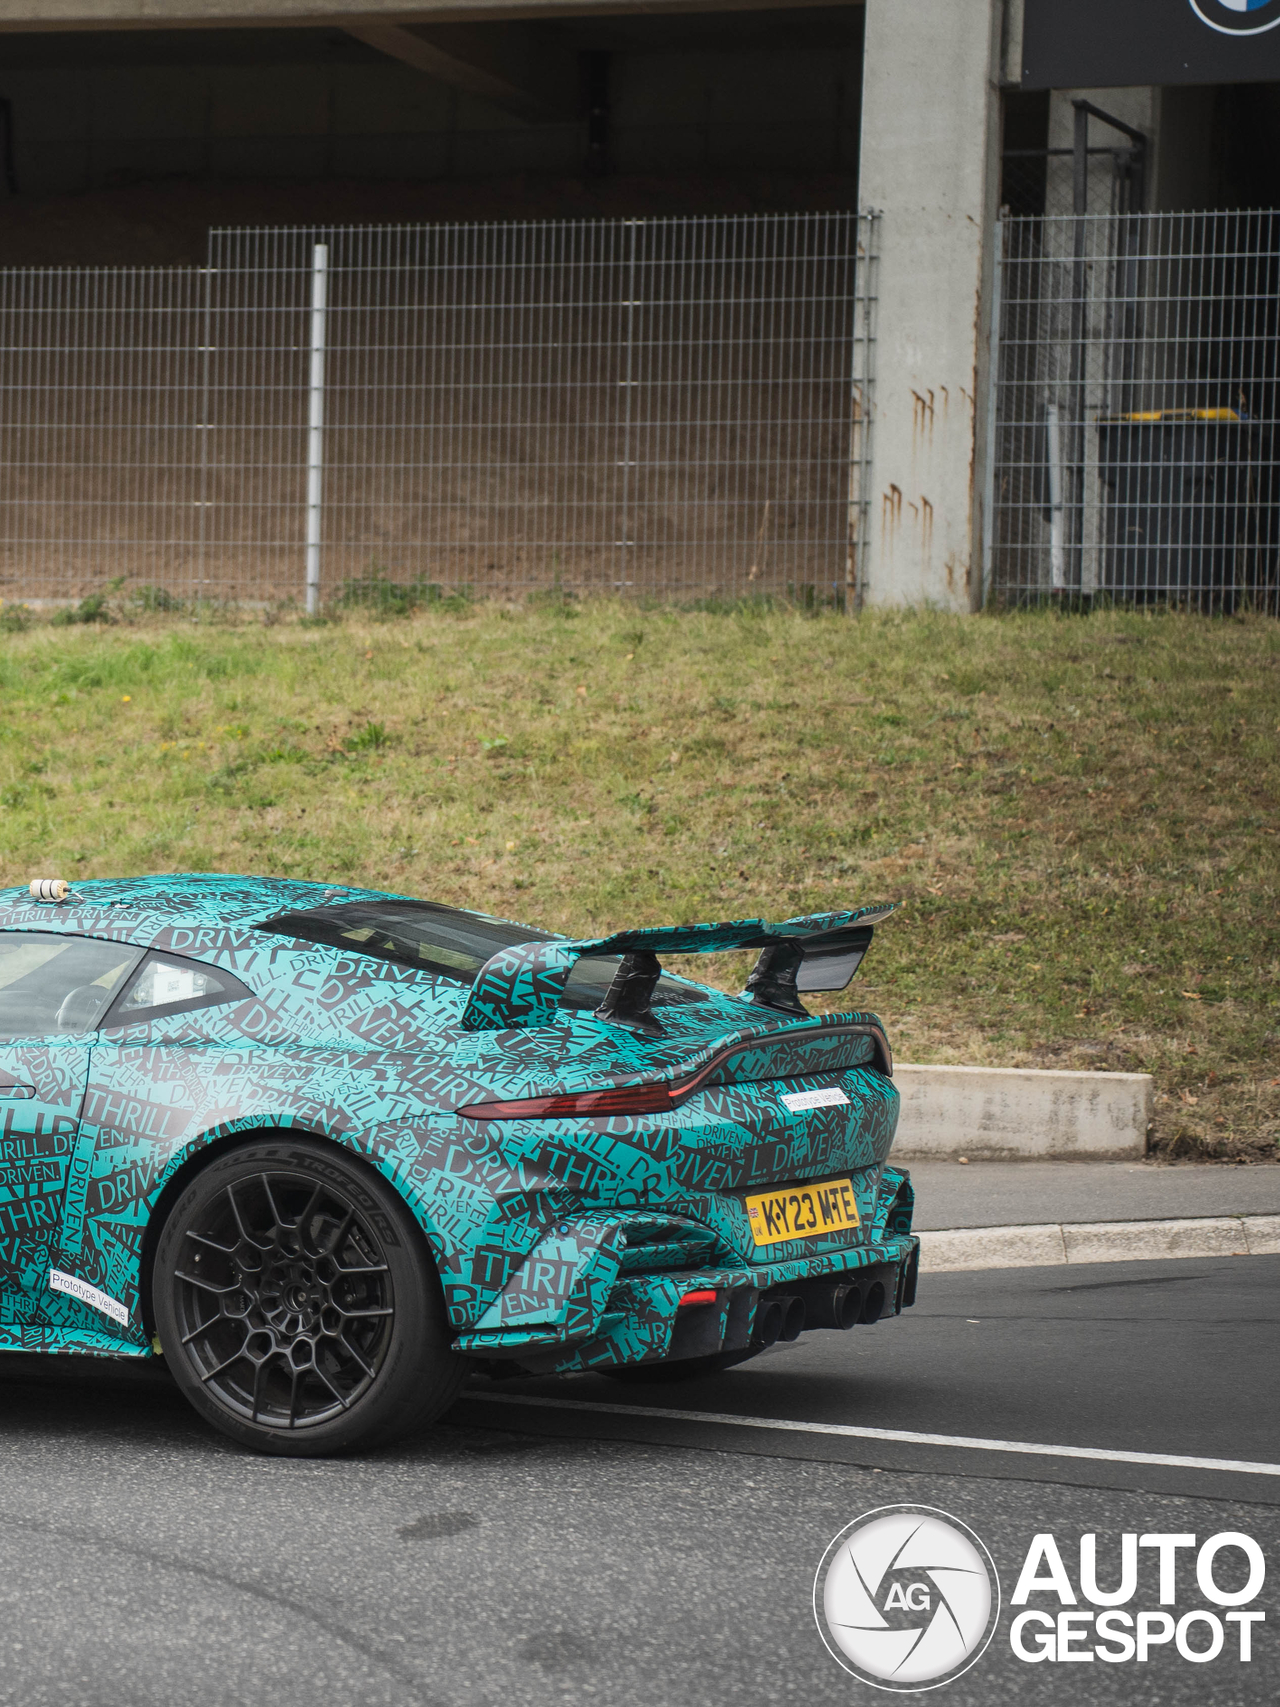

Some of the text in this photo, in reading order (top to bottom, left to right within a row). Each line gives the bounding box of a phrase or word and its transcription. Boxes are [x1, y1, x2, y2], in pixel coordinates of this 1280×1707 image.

[87, 1088, 172, 1139] THRILL
[783, 1090, 846, 1110] Prototype Vehicle
[404, 1179, 474, 1252] THRILL.
[761, 1185, 856, 1236] KY23 MTE
[52, 1273, 126, 1321] Prototype Vehicle
